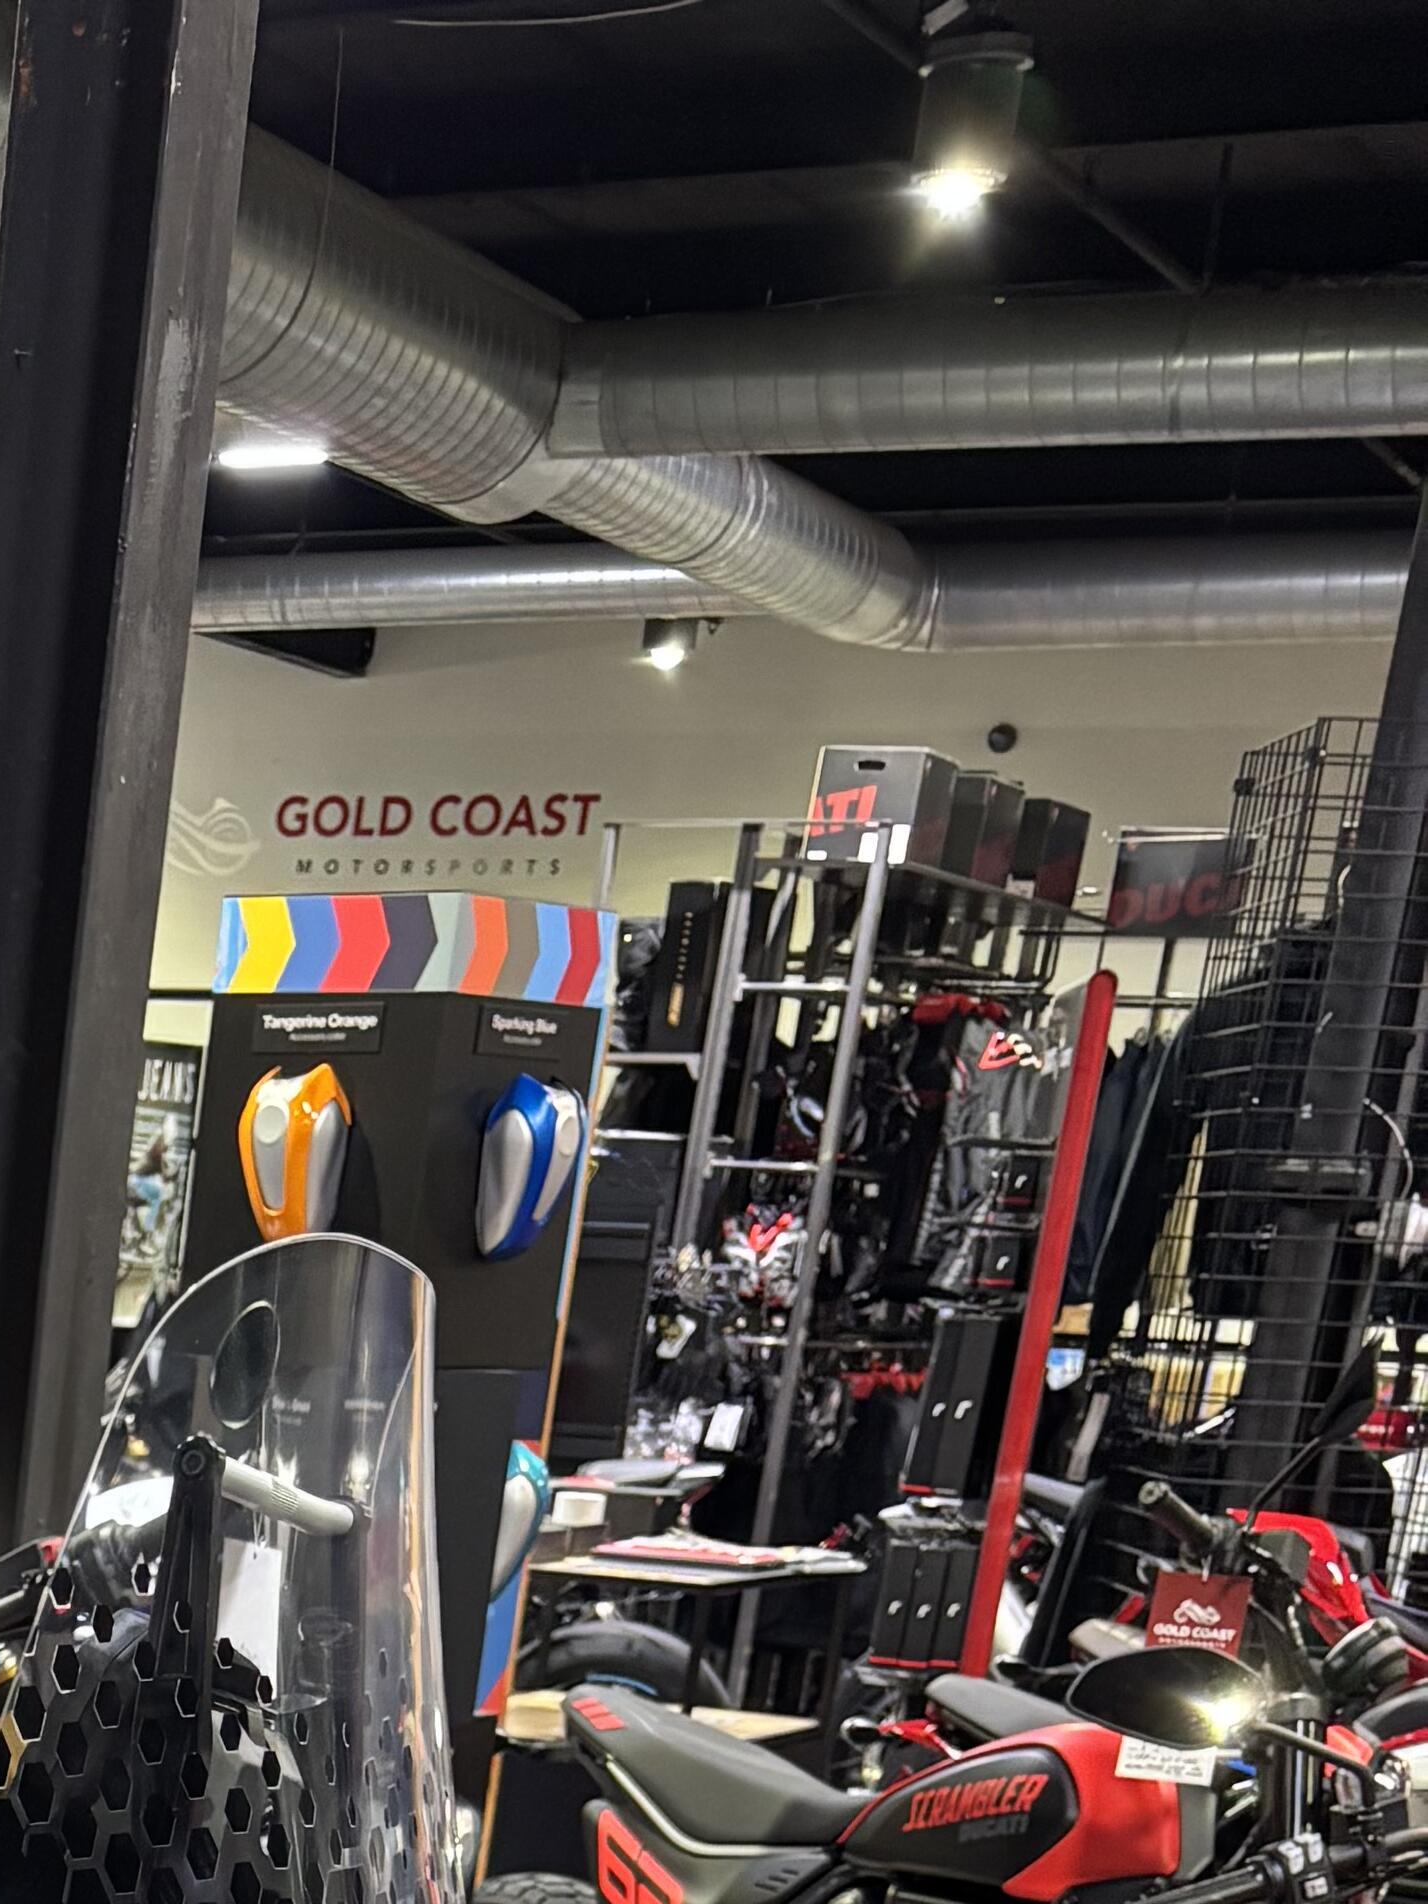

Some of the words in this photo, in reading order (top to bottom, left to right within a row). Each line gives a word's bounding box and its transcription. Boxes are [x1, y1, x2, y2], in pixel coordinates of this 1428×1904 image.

[276, 795, 412, 837] GOLD
[430, 793, 601, 836] COAST
[296, 858, 561, 876] MOTORSPORTS
[328, 1015, 378, 1032] Orange
[903, 1774, 1049, 1832] SCRAMBLER
